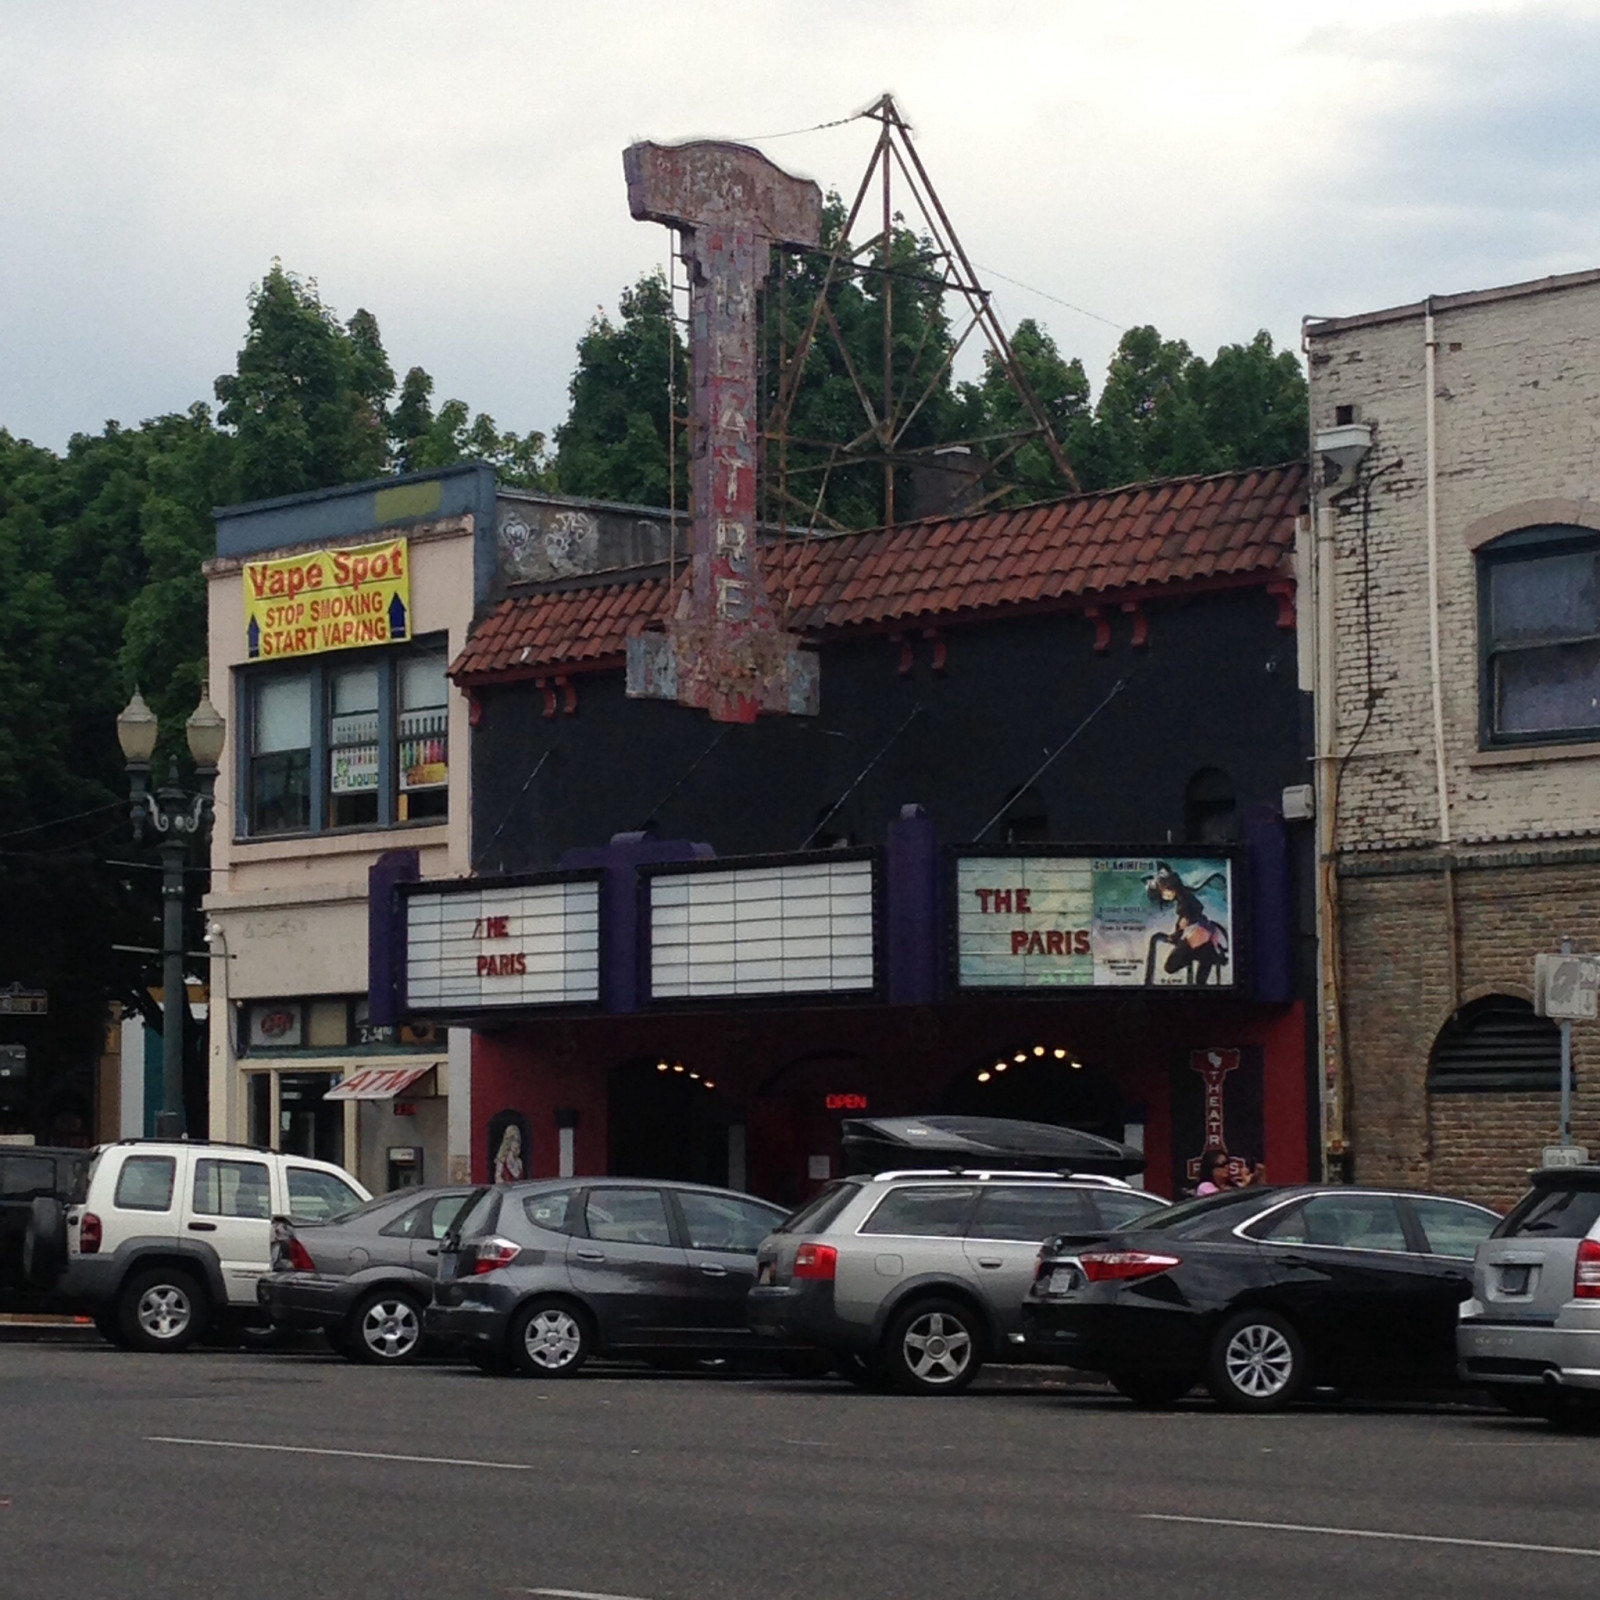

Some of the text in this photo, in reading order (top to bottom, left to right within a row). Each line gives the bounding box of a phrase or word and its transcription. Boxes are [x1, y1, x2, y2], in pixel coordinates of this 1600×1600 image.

[712, 230, 753, 620] HEATRE
[249, 548, 403, 600] Vape Spot
[265, 591, 383, 628] STOP SMOKING
[263, 617, 386, 655] START VAPING
[975, 888, 1031, 914] THE
[1011, 930, 1090, 956] PARIS
[477, 953, 527, 977] PARIS
[333, 1069, 425, 1092] ATM
[826, 1094, 867, 1109] OPEN
[1208, 1070, 1220, 1145] THEATR
